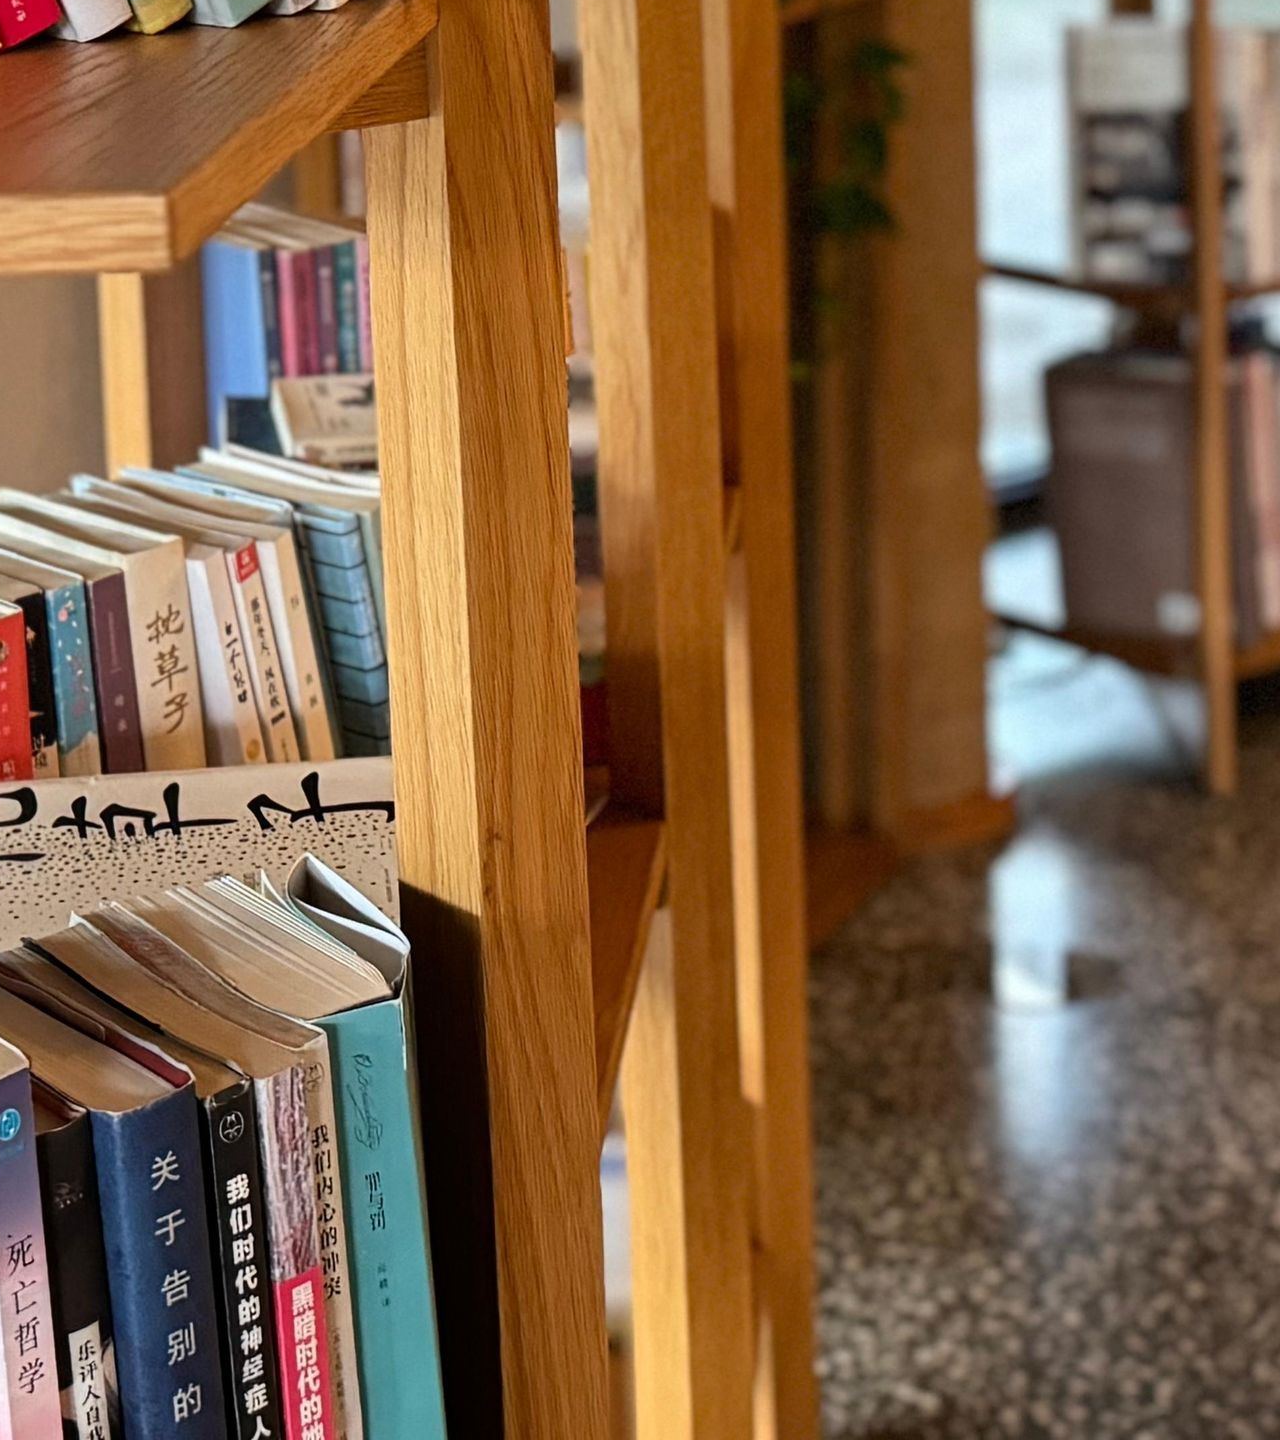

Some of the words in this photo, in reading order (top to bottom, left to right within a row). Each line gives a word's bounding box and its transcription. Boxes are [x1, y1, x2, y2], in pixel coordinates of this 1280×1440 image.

[146, 604, 190, 735] 枕草子
[310, 1123, 341, 1300] 我们内心的冲突
[364, 1171, 386, 1231] 罪与罚
[6, 1234, 45, 1394] 死亡哲学
[151, 1151, 202, 1424] 关于告别的
[225, 1174, 271, 1440] 我们时代的神经症人
